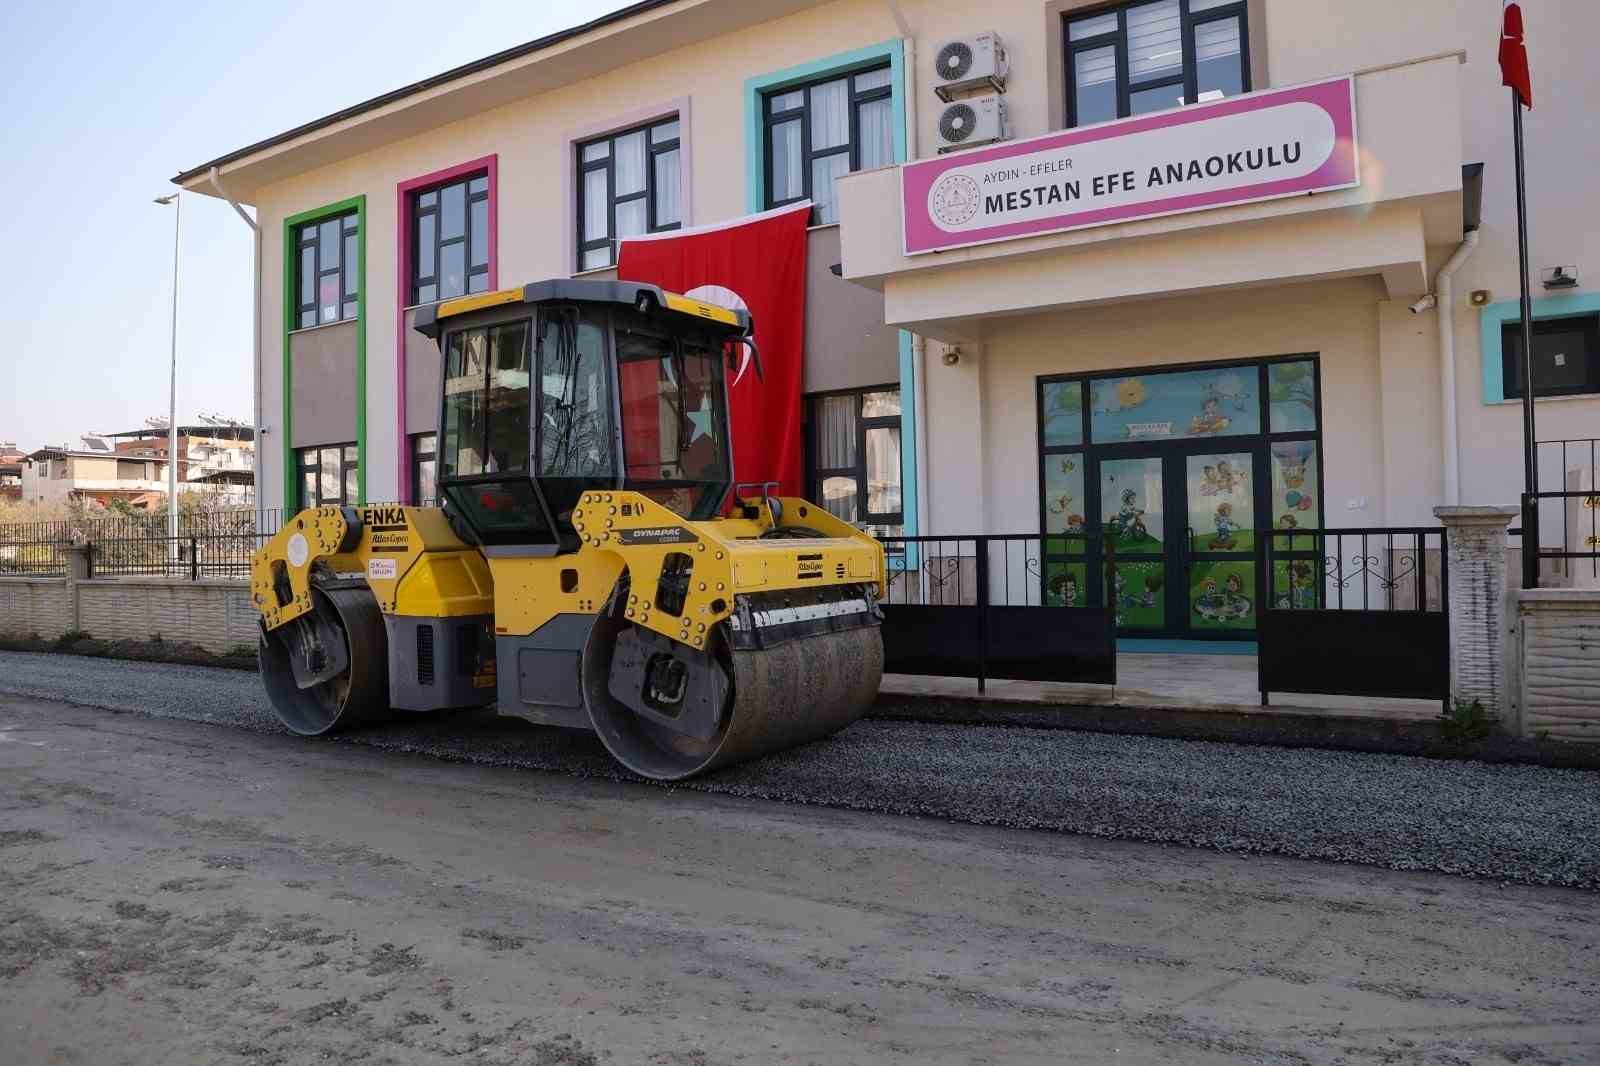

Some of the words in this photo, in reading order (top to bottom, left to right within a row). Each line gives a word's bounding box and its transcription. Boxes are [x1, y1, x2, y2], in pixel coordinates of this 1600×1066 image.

[983, 167, 1020, 185] AYDIN
[1029, 158, 1074, 177] EFELER
[984, 180, 1081, 215] MESTAN
[1092, 170, 1136, 197] EFE
[1146, 141, 1302, 188] ANAOKULU
[363, 508, 406, 526] ENKA
[632, 527, 681, 537] DYNAPAC
